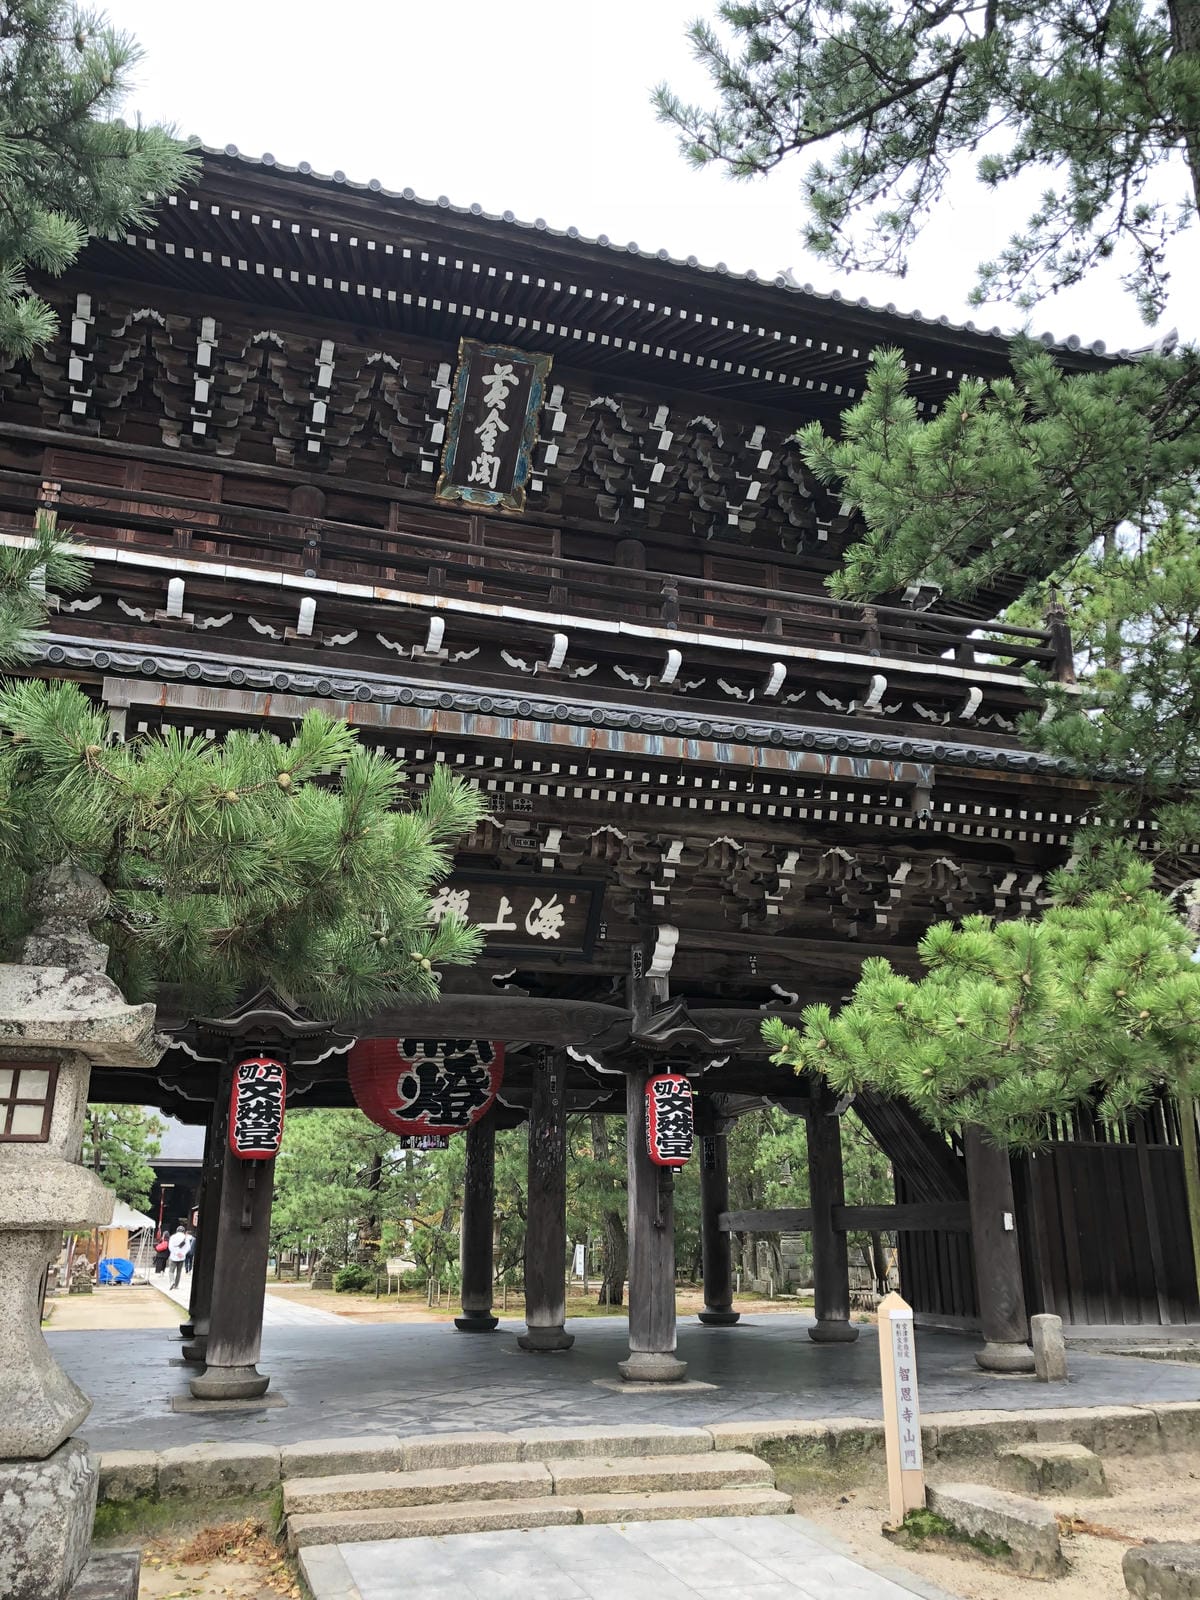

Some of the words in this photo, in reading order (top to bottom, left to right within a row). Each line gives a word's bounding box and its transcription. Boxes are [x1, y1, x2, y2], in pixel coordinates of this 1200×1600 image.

[234, 1078, 283, 1152] 文殊堂
[653, 1095, 694, 1160] 文殊堂
[898, 1365, 917, 1465] 智恩寺山門
